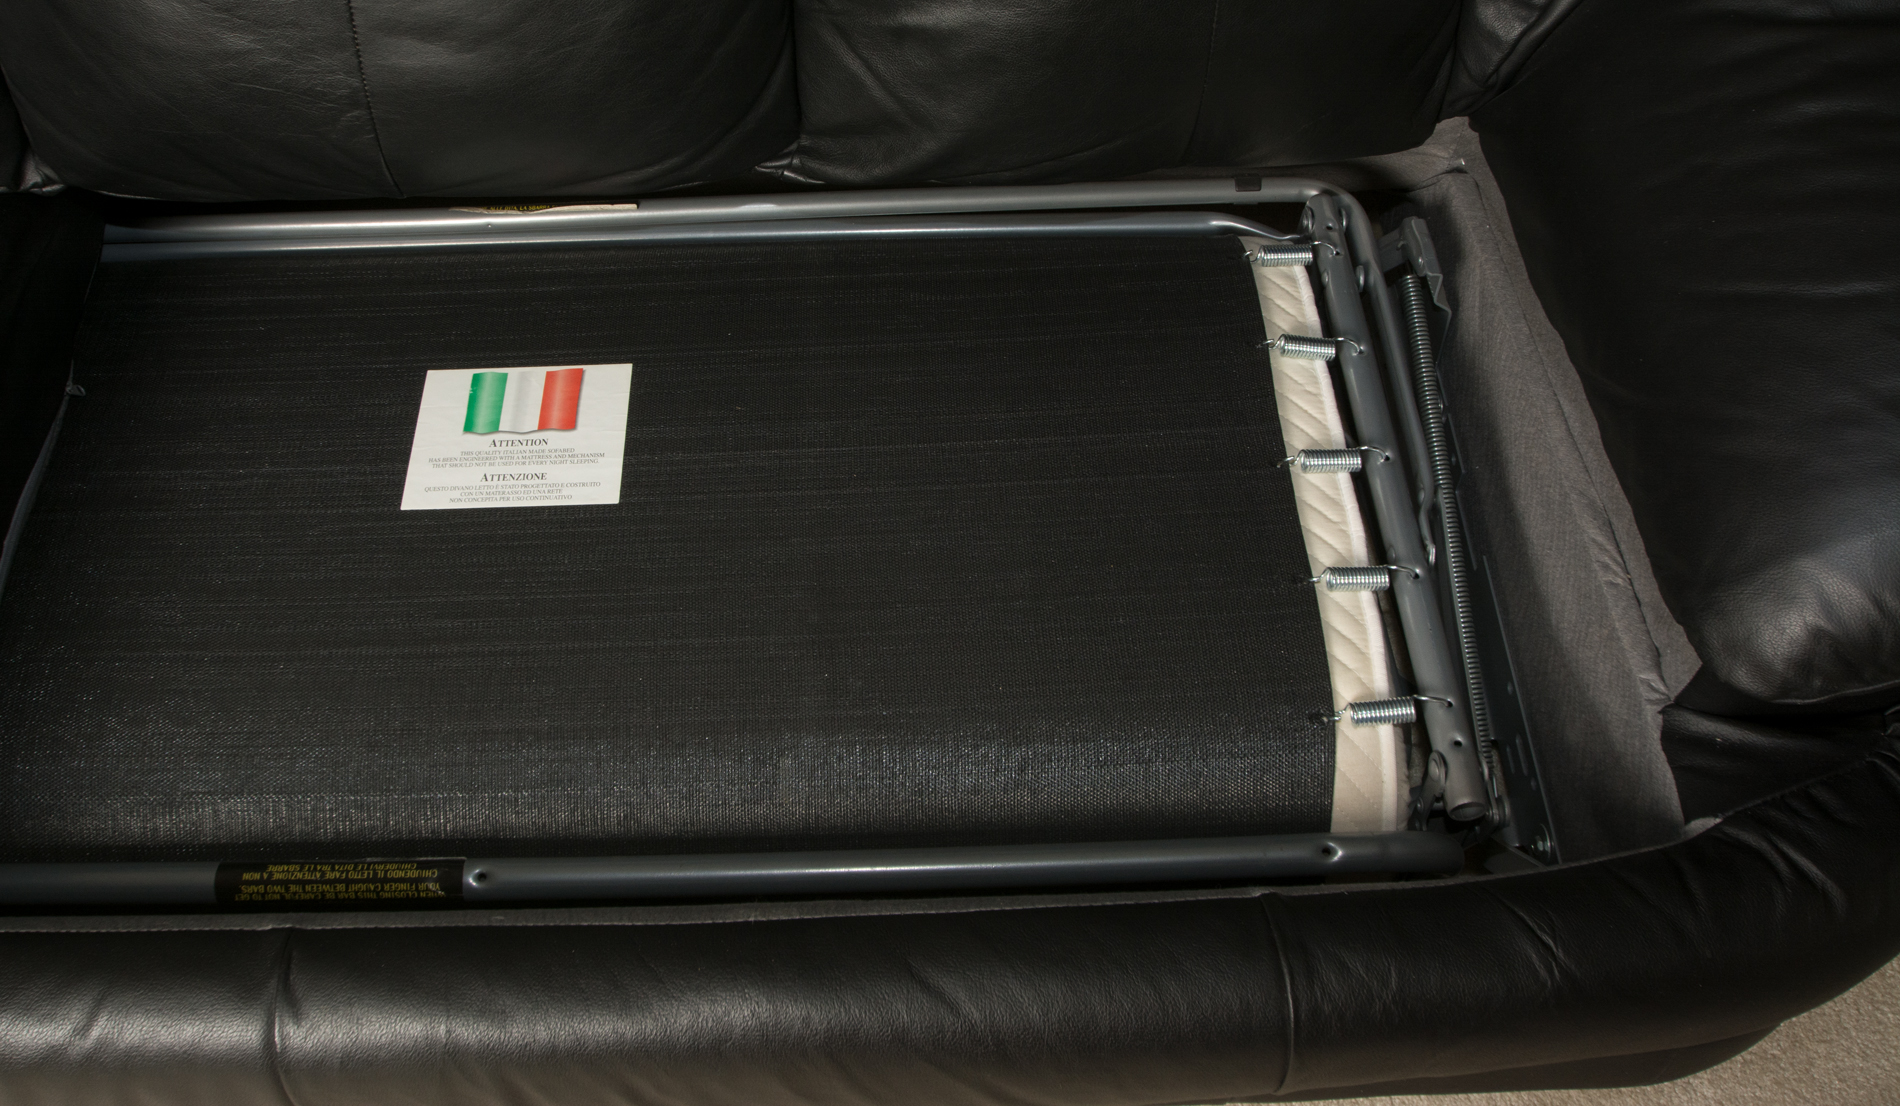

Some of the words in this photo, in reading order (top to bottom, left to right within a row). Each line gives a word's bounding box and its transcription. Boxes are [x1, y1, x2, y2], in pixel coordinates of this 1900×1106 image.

[489, 439, 548, 447] ATTENTION
[480, 473, 547, 482] ATTENZIONE
[242, 872, 260, 880] NON
[263, 872, 269, 880] A
[270, 871, 321, 880] ATTENZIONE
[324, 871, 346, 879] FARE
[348, 870, 373, 879] LETTO
[377, 870, 384, 878] IL
[387, 869, 438, 878] CHIUDENDO
[239, 885, 264, 893] BARS.
[267, 885, 285, 893] TWO
[288, 885, 303, 893] THE
[305, 884, 345, 892] BETWEEN
[348, 883, 381, 891] CAUGHT
[384, 883, 415, 891] FINGER
[418, 882, 440, 890] YOUR
